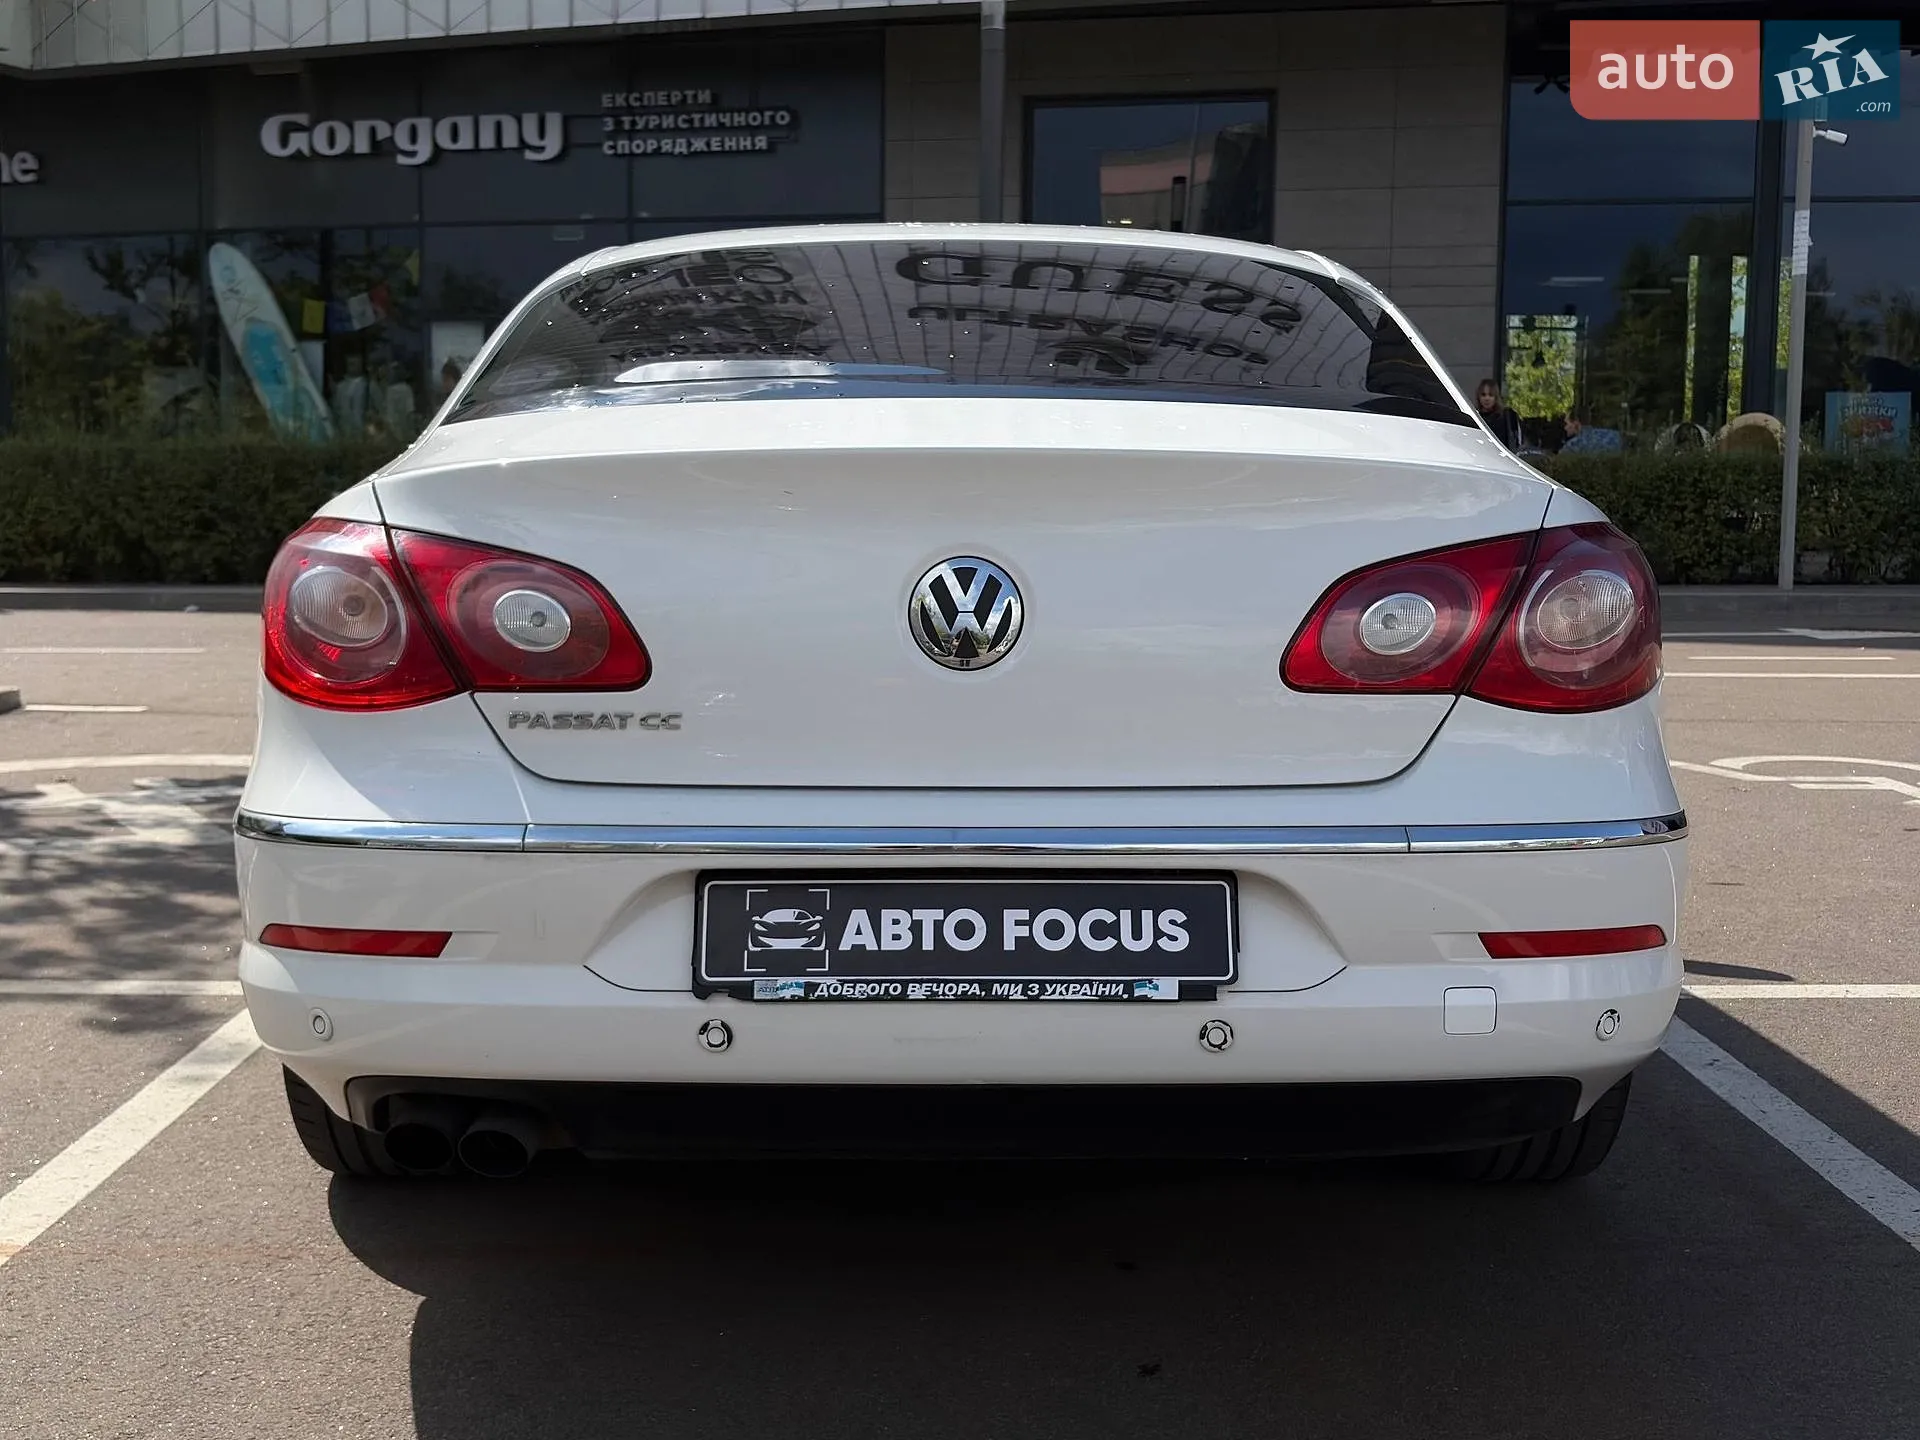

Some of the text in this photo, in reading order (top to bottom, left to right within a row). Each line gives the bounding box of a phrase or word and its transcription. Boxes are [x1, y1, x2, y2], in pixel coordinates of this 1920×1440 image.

[601, 89, 713, 108] ЕКСПЕРТИ
[602, 110, 791, 132] З ТУРИСТИЧНОГО
[260, 111, 563, 165] Gorgany
[603, 135, 768, 156] СПОРЯДЖЕННЯ
[508, 711, 683, 731] PASSAT CC
[838, 908, 1190, 952] АВТО FOCUS
[814, 983, 902, 997] ДОБРОГО
[906, 983, 986, 997] ВЕЧОРА,
[991, 983, 1023, 996] МИ
[1027, 983, 1039, 995] З
